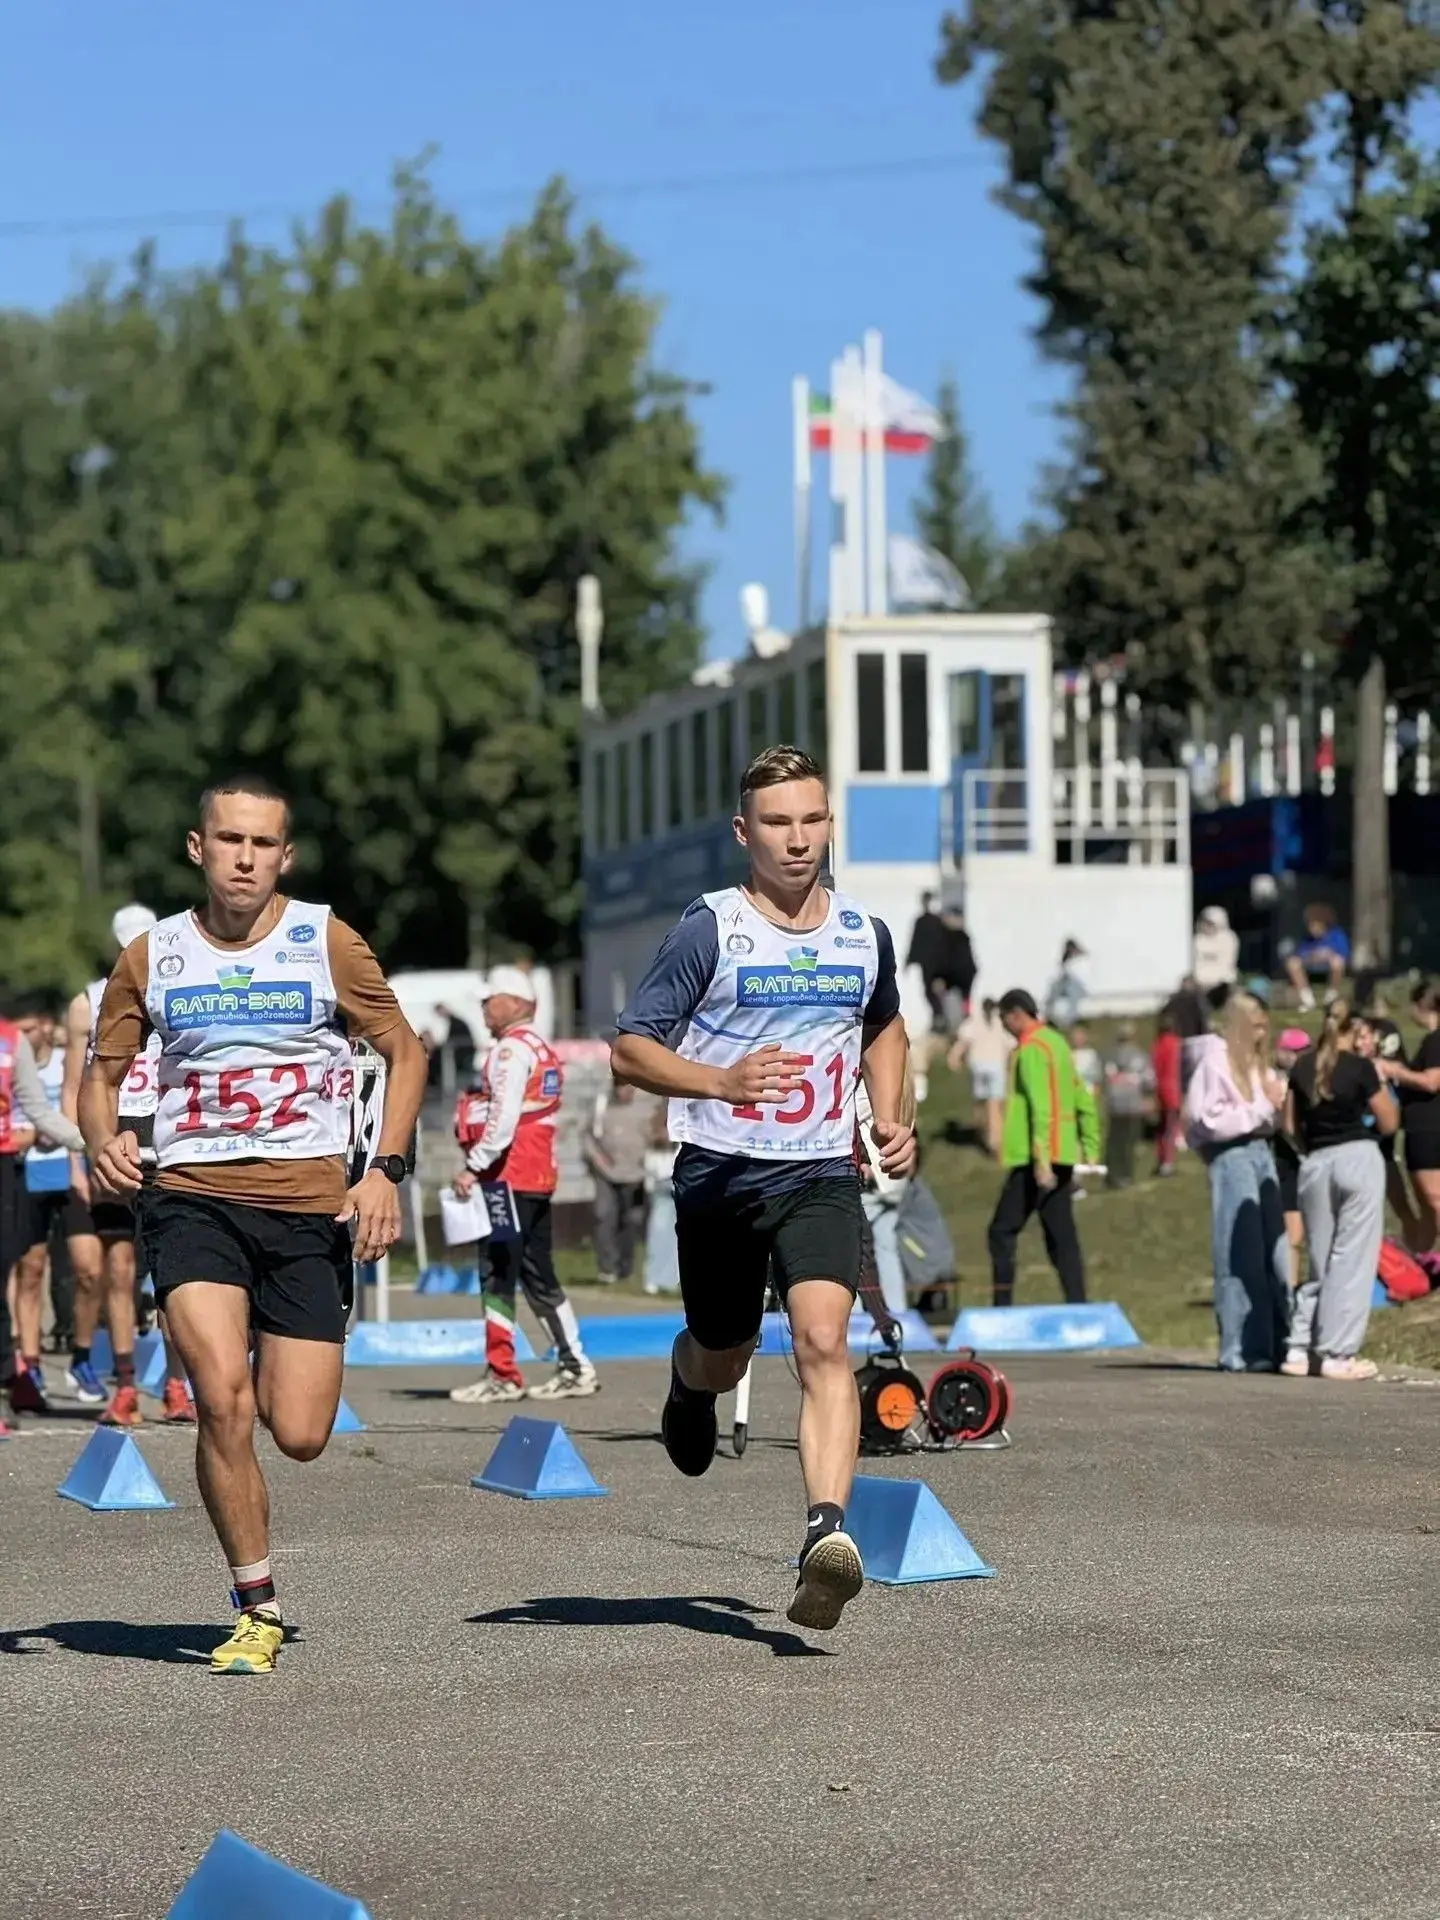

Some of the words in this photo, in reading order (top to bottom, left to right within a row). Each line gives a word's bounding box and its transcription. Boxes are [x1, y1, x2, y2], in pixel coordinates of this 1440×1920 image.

[744, 975, 861, 994] ЯЛТА-ЗАЙ
[170, 990, 305, 1016] ЯЛТА-ЗАЙ
[743, 994, 769, 1004] центр
[772, 993, 819, 1003] спортивной
[197, 1012, 249, 1023] спортивной
[252, 1010, 305, 1020] подготовки
[175, 1062, 309, 1132] 152
[745, 1137, 836, 1152] ЗАИНСК
